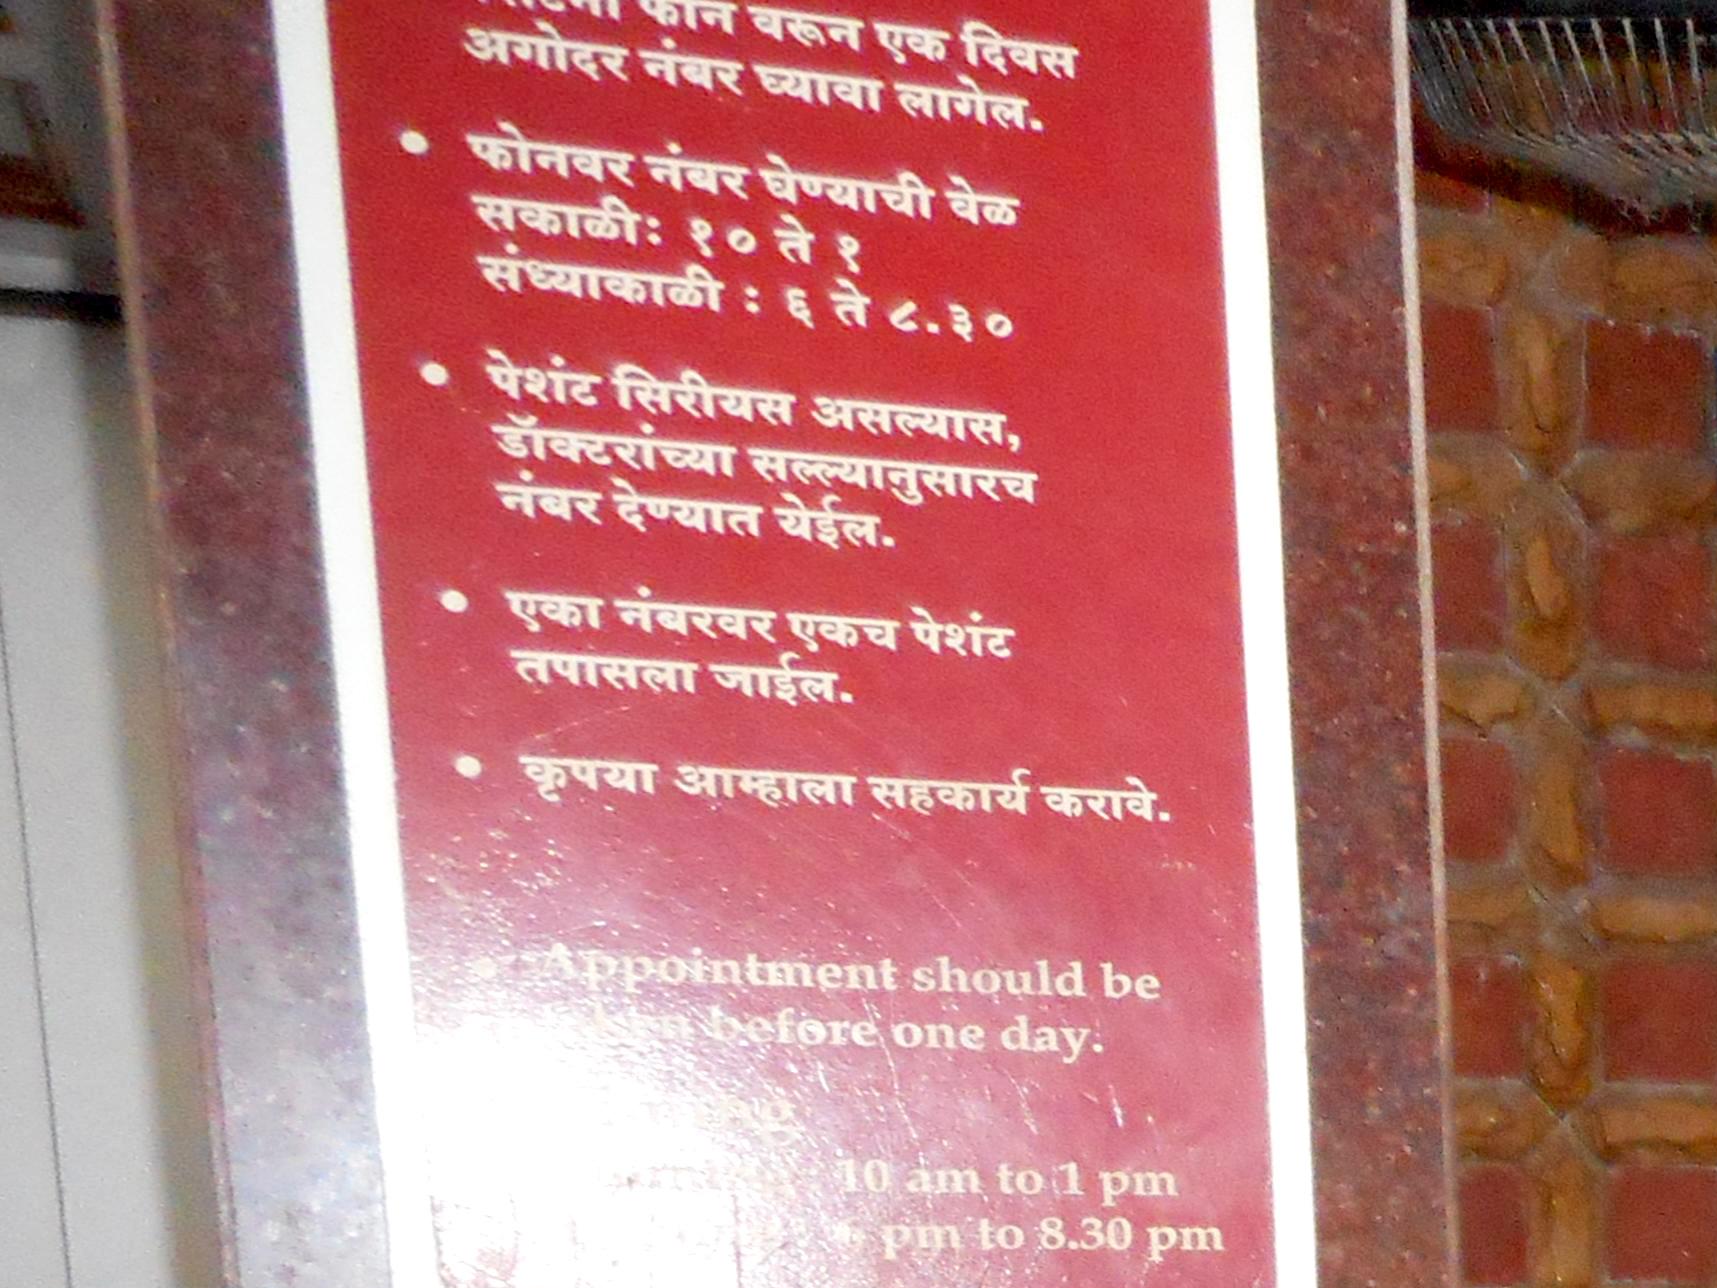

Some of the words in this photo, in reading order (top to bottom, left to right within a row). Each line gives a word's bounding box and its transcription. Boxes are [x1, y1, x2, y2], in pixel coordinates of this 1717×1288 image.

[463, 22, 630, 82] अगोदर
[640, 37, 745, 96] नंबर
[896, 75, 1046, 132] लागेल.
[748, 3, 866, 54] वरून
[874, 17, 952, 64] एक
[961, 20, 1080, 79] दिवस
[466, 121, 635, 188] फोनवर
[645, 142, 749, 199] नंबर
[758, 153, 936, 221] घेण्याची
[945, 175, 1022, 228] वेळ
[689, 215, 758, 259] १०
[774, 213, 816, 267] ते
[838, 231, 862, 275] १
[477, 243, 724, 314] संध्याकाळी
[786, 286, 816, 330] ६
[830, 279, 872, 329] ते
[889, 299, 1016, 345] ८.३०
[485, 347, 603, 409] पेशंट
[611, 362, 797, 428] सिरीयस
[811, 394, 1023, 453] असल्यास,
[491, 412, 738, 479] डॉक्टरांच्या
[749, 446, 1040, 507] सल्ल्यानुसारच
[494, 469, 603, 526] नंबर
[612, 476, 763, 539] देण्यात
[773, 493, 897, 551] येईल.
[505, 589, 604, 634] एका
[613, 585, 777, 645] नंबरवर
[788, 610, 902, 654] एकच
[910, 606, 1016, 661] पेशंट
[509, 648, 700, 697] तपासला
[709, 651, 854, 707] जाईल.
[519, 755, 660, 804] कृपया
[674, 761, 857, 808] आम्हाला
[867, 768, 1032, 817] सहकार्य
[1039, 775, 1172, 824] करावे.
[541, 942, 900, 993] Appointment
[912, 956, 1086, 999] should
[1101, 962, 1163, 1001] be
[710, 1005, 879, 1047] before
[893, 1018, 986, 1051] one
[1000, 1015, 1104, 1064] day.
[838, 1158, 892, 1194] 10
[905, 1164, 983, 1195] am
[996, 1160, 1043, 1197] to
[1057, 1161, 1085, 1195] 1
[1100, 1168, 1181, 1207] pm
[883, 1222, 962, 1262] pm
[978, 1216, 1035, 1250] to
[1038, 1216, 1134, 1251] 8.30
[1149, 1223, 1227, 1263] pm
